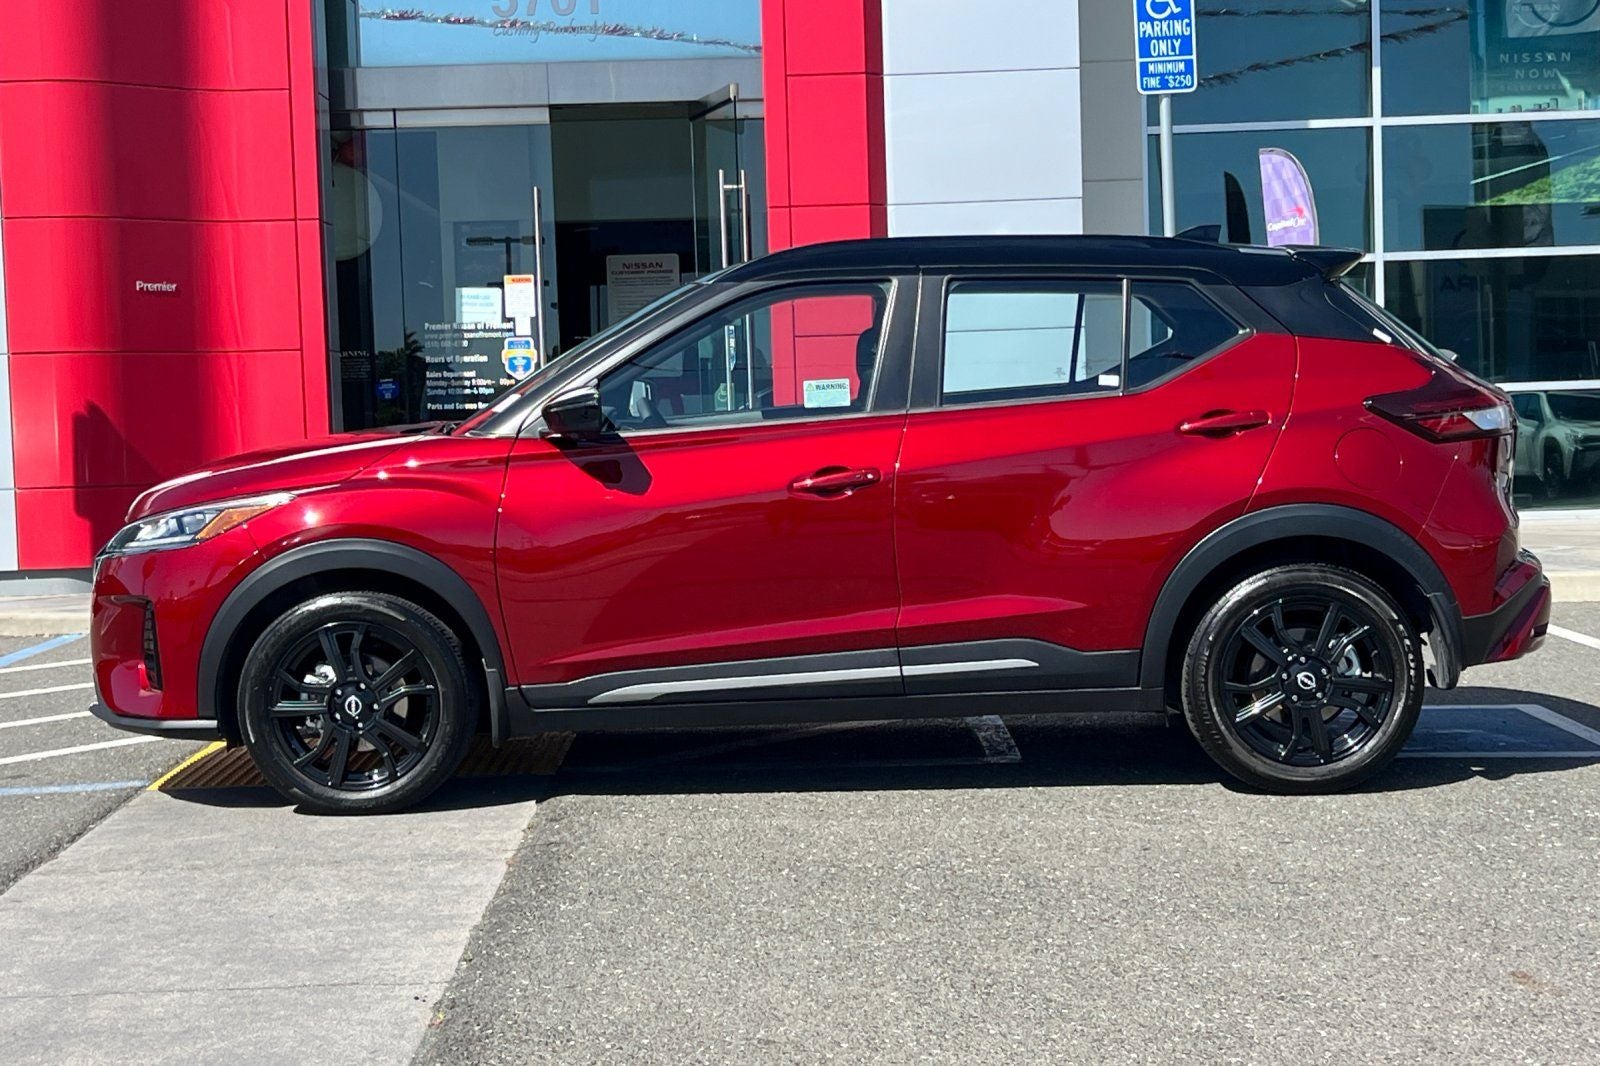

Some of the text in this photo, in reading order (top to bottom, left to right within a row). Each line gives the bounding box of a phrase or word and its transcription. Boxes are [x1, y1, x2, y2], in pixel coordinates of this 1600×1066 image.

[1140, 19, 1190, 37] PARKING
[1150, 39, 1181, 56] ONLY
[1500, 52, 1571, 63] NISSAN
[1148, 61, 1185, 74] MINIMUM
[1515, 68, 1557, 79] NOW
[1143, 74, 1192, 88] FINE $250
[622, 262, 663, 270] NISSAN
[136, 280, 177, 292] Premier
[424, 322, 451, 330] Premier
[425, 355, 444, 363] Hours
[427, 402, 443, 410] Parts
